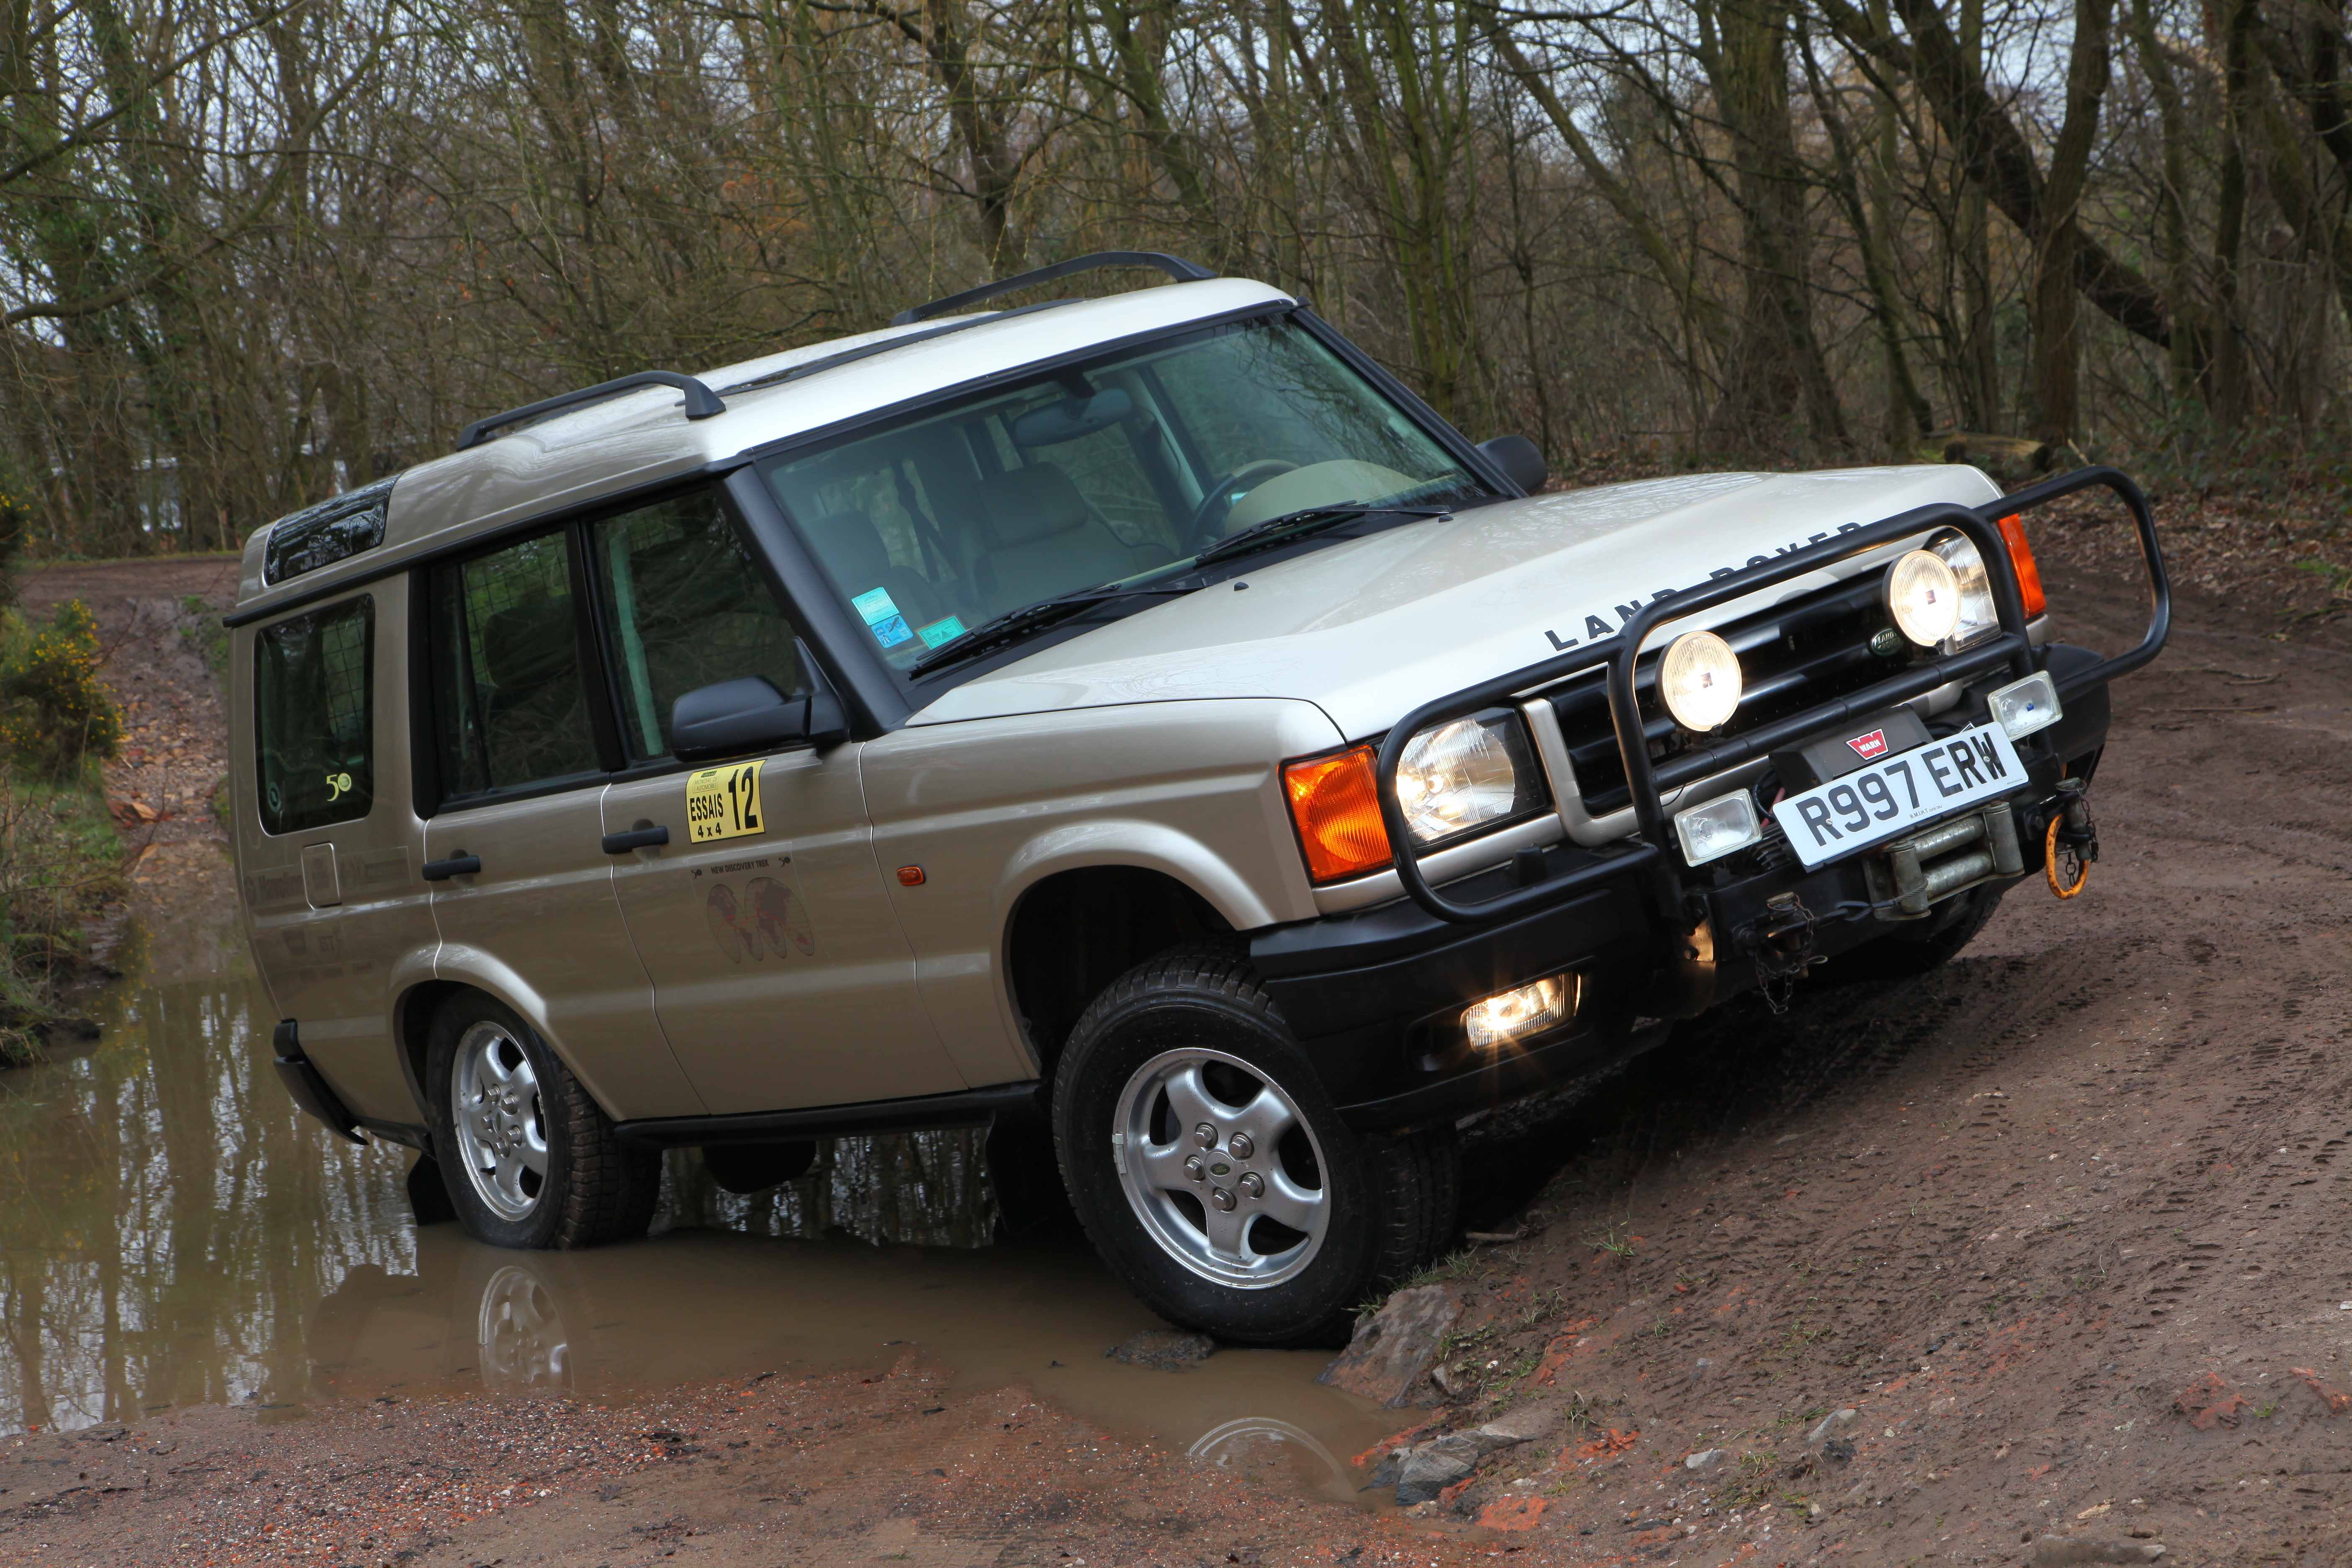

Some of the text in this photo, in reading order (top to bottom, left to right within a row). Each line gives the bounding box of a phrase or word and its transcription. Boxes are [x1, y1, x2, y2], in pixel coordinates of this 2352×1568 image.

[1878, 632, 1893, 644] LAND
[1859, 739, 1882, 752] WARN
[1795, 732, 2007, 847] R997 ERW
[728, 766, 758, 831] 12
[690, 793, 723, 822] ESSAIS
[698, 825, 704, 838] 4
[715, 822, 722, 835] 4
[725, 861, 754, 872] DISCOVERY
[755, 859, 769, 868] TREK
